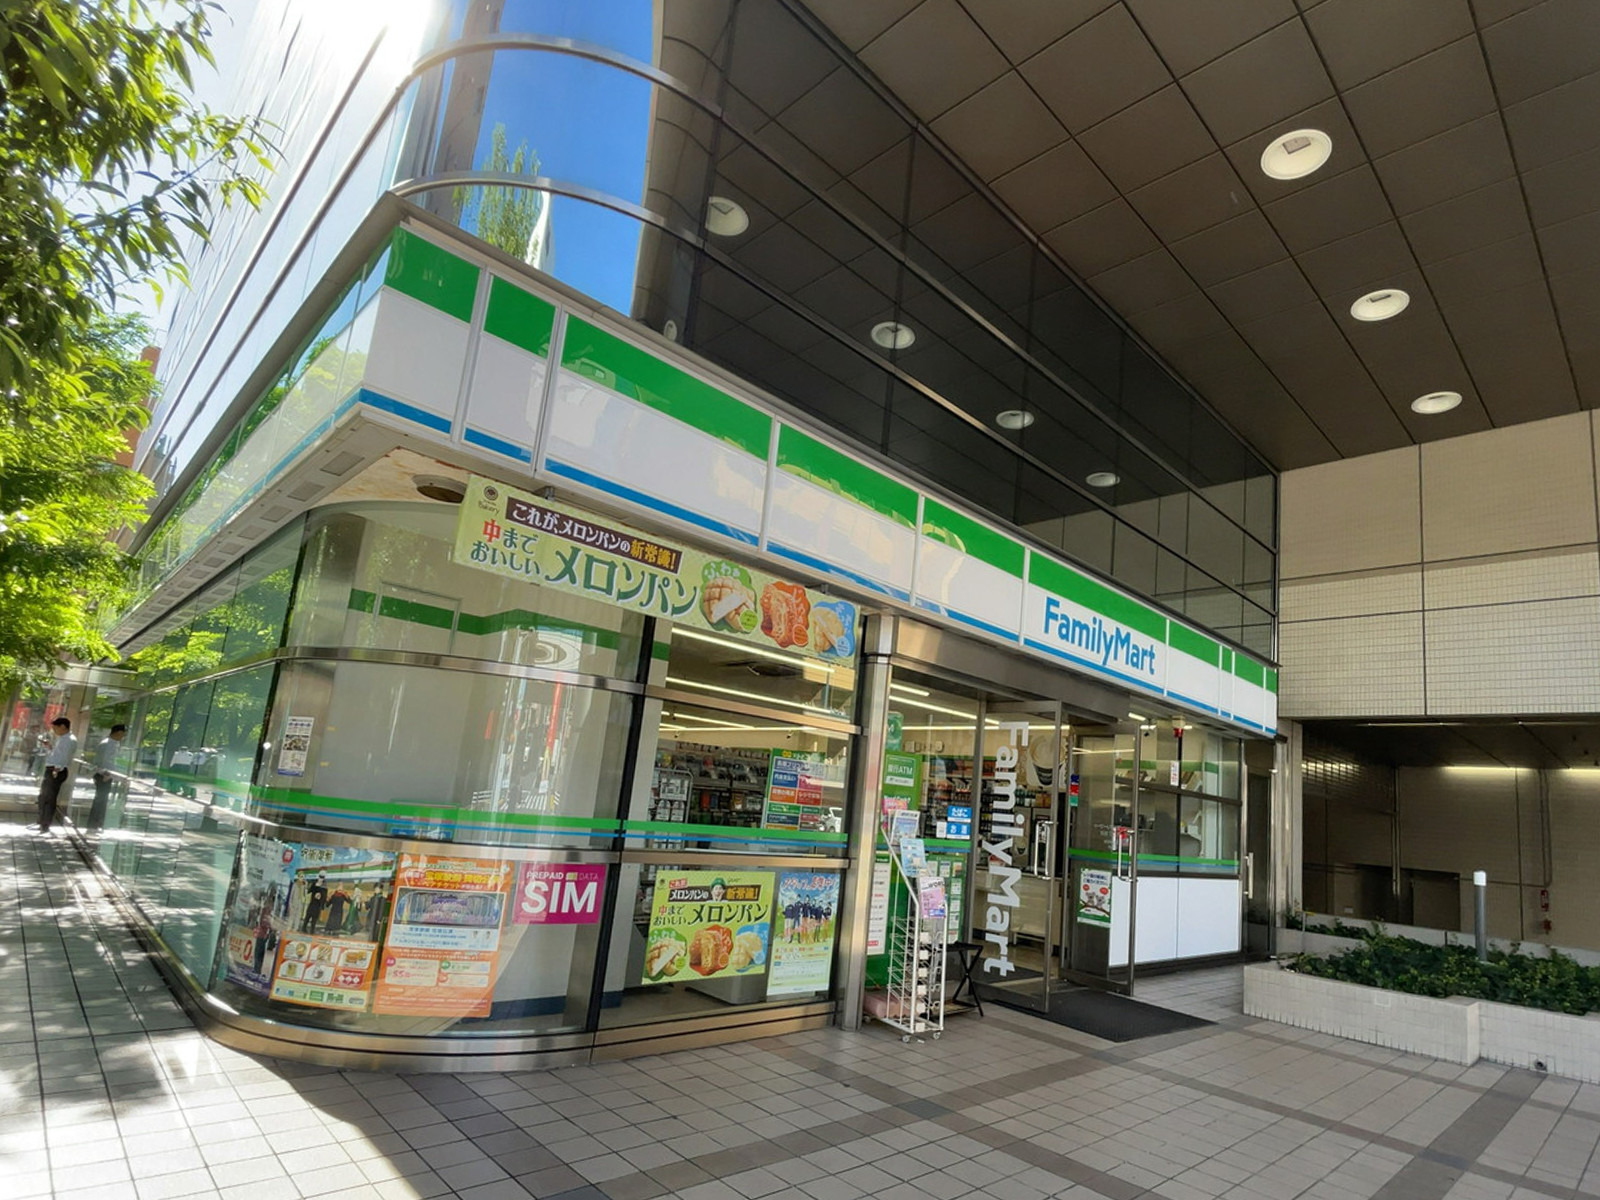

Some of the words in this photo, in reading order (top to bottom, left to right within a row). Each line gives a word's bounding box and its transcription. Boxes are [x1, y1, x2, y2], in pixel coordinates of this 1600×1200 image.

[482, 518, 538, 555] 中まで
[471, 541, 541, 577] おいしい
[545, 546, 697, 617] メロンパン
[1044, 596, 1155, 675] FamilyMart
[982, 721, 1029, 978] FamilyMart
[526, 871, 564, 880] PREPAID
[579, 872, 599, 880] DATA
[521, 881, 598, 914] SIM
[659, 905, 684, 916] 中まで
[688, 904, 768, 925] メロンパン
